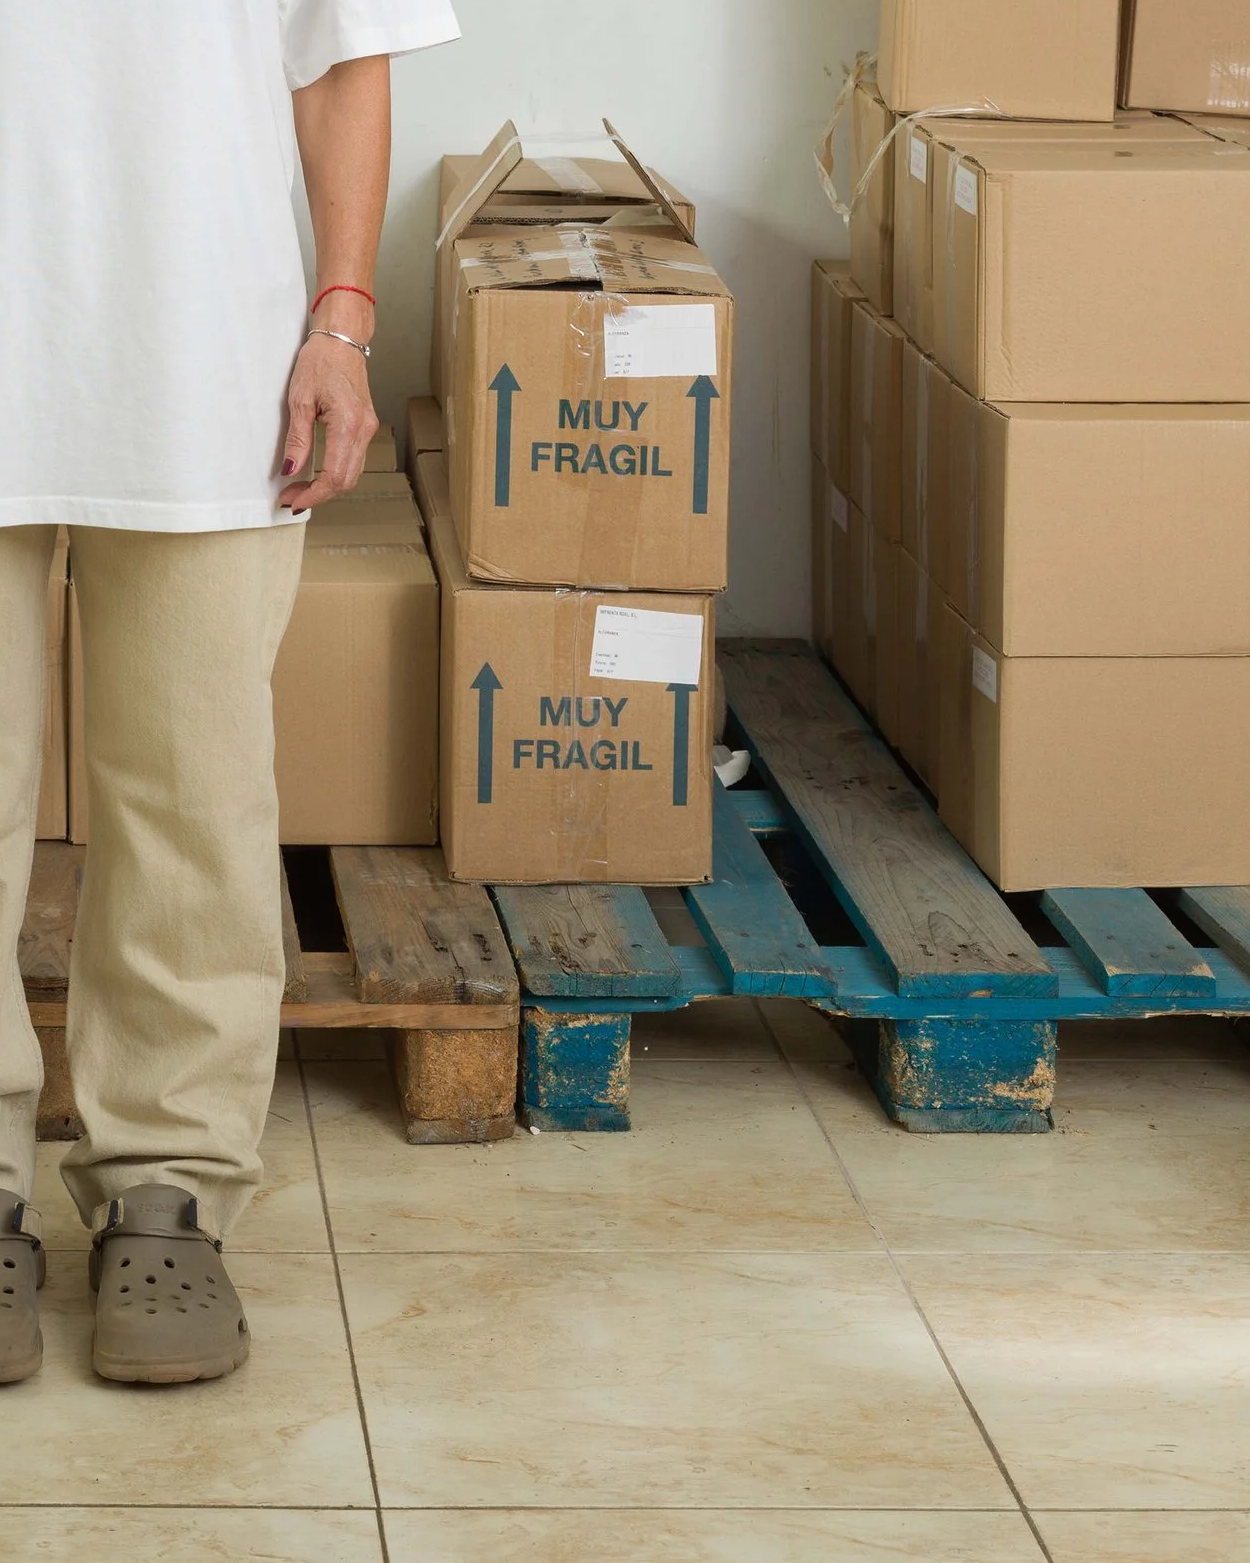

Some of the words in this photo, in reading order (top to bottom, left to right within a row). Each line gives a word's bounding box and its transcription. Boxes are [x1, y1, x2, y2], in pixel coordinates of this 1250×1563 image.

[558, 399, 648, 431] MUY
[531, 441, 673, 477] FRAGIL
[539, 696, 629, 727] MUY
[513, 739, 653, 771] FRAGIL
